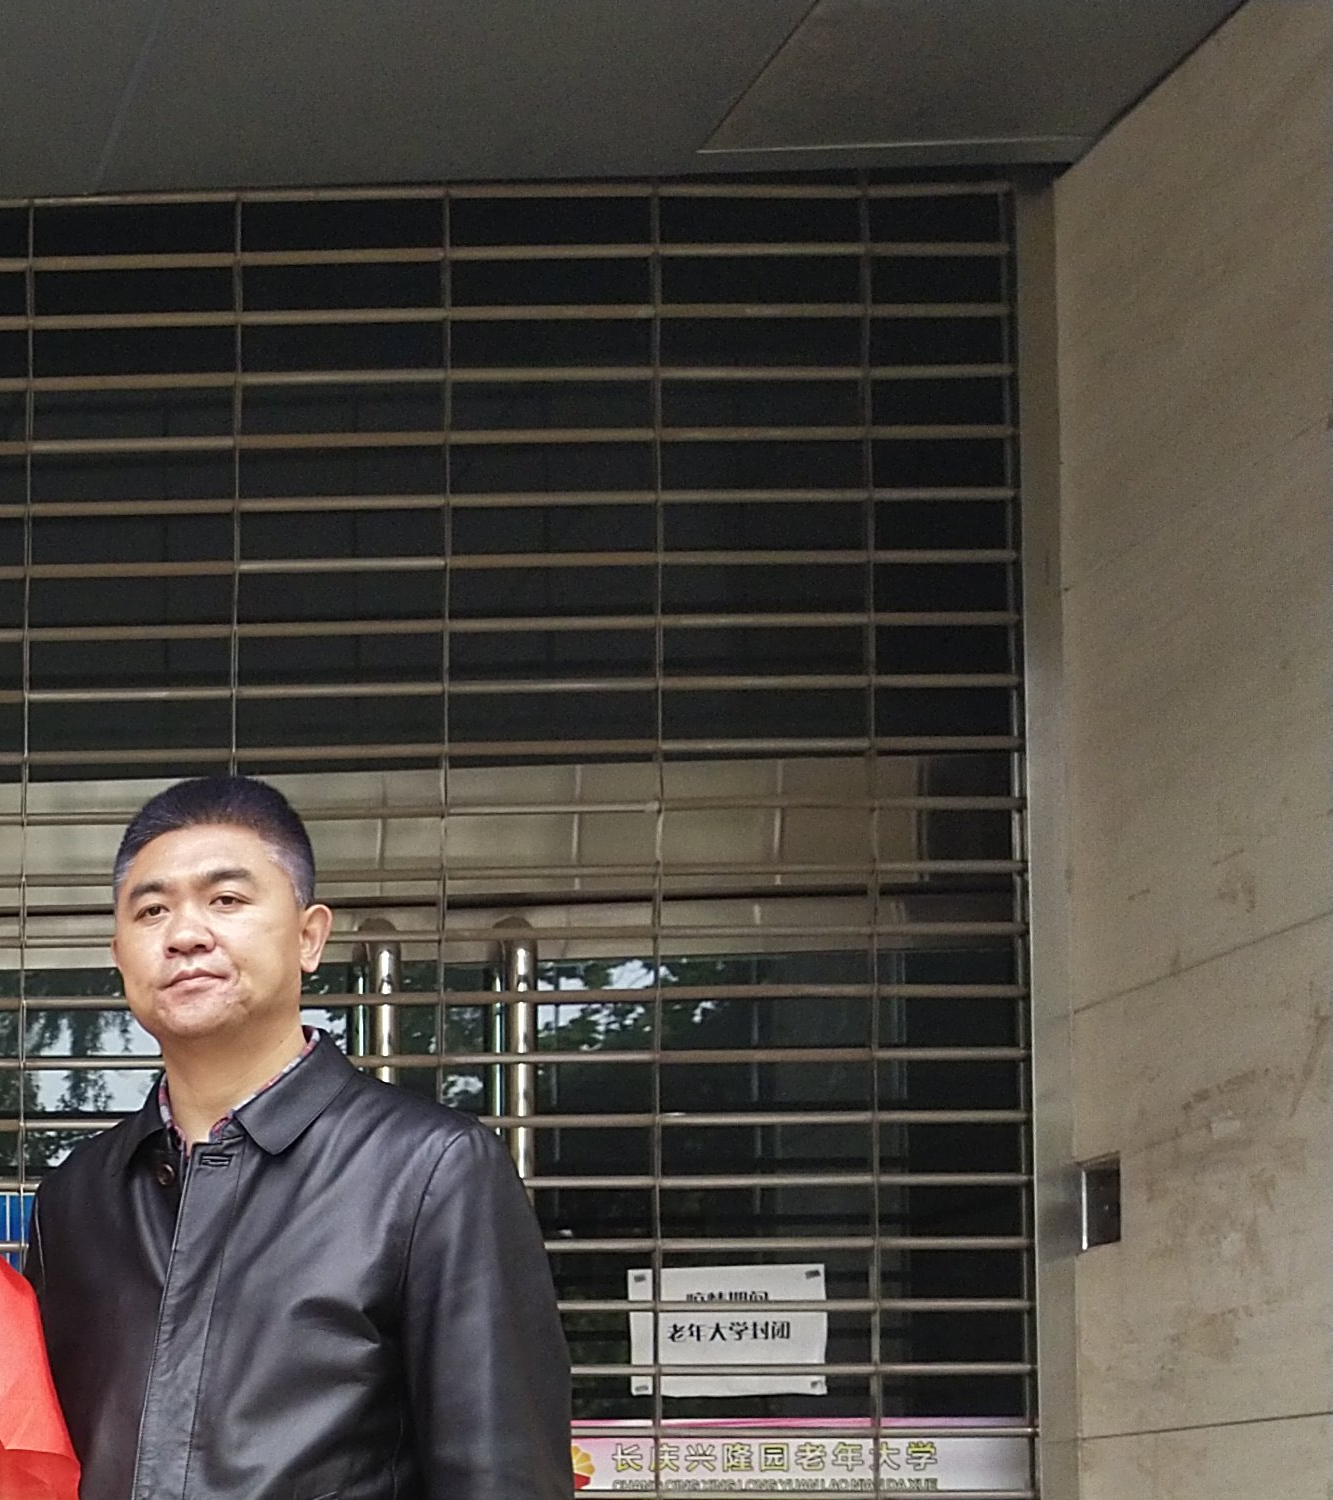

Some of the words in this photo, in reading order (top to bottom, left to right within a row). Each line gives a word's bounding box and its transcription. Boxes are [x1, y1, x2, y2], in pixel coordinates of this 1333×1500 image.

[667, 1320, 791, 1342] 老年大学封闭
[611, 1441, 938, 1472] 长庆兴隆园老年大学
